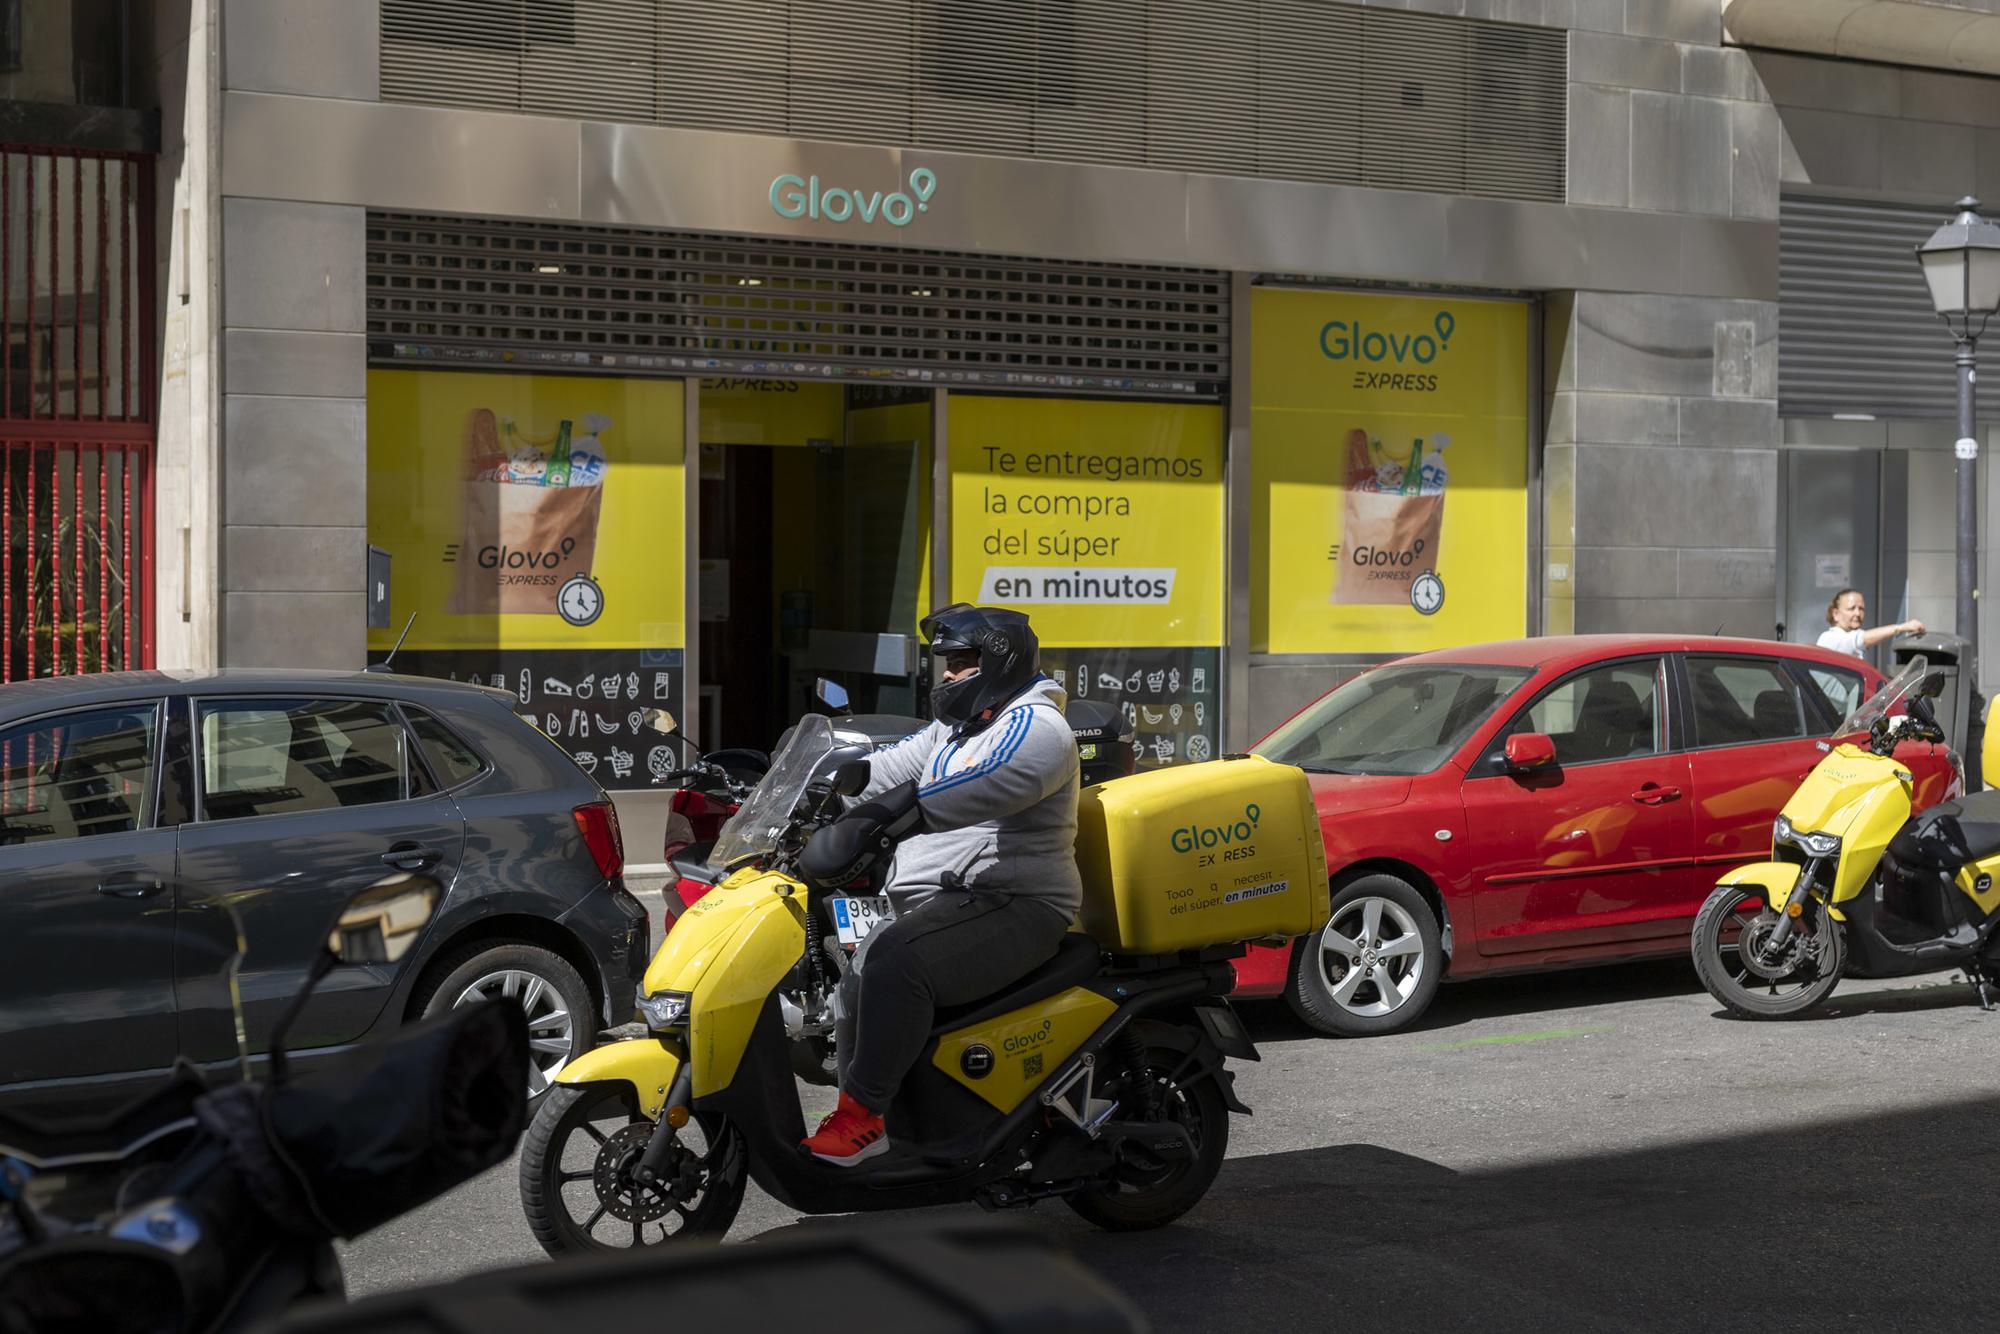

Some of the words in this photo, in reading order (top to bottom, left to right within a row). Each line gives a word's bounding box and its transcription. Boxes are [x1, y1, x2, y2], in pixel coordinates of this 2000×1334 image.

[769, 174, 914, 226] Glovo
[1320, 320, 1437, 364] Glovo
[1353, 371, 1437, 391] EXPRESS
[983, 446, 1016, 473] Te
[1025, 450, 1203, 481] entregamos
[984, 487, 1007, 513] la
[1017, 495, 1130, 521] compra
[478, 545, 560, 569] Glovo
[983, 529, 1027, 555] del
[1037, 530, 1120, 562] súper
[1353, 546, 1414, 566] Glovo
[498, 575, 558, 586] EXPRESS
[994, 576, 1032, 598] en
[1043, 570, 1167, 598] minutos
[1368, 570, 1411, 580] EXPRESS
[1171, 821, 1251, 853] Glovo
[1242, 882, 1287, 900] minutos
[1003, 1030, 1047, 1052] Glovo
